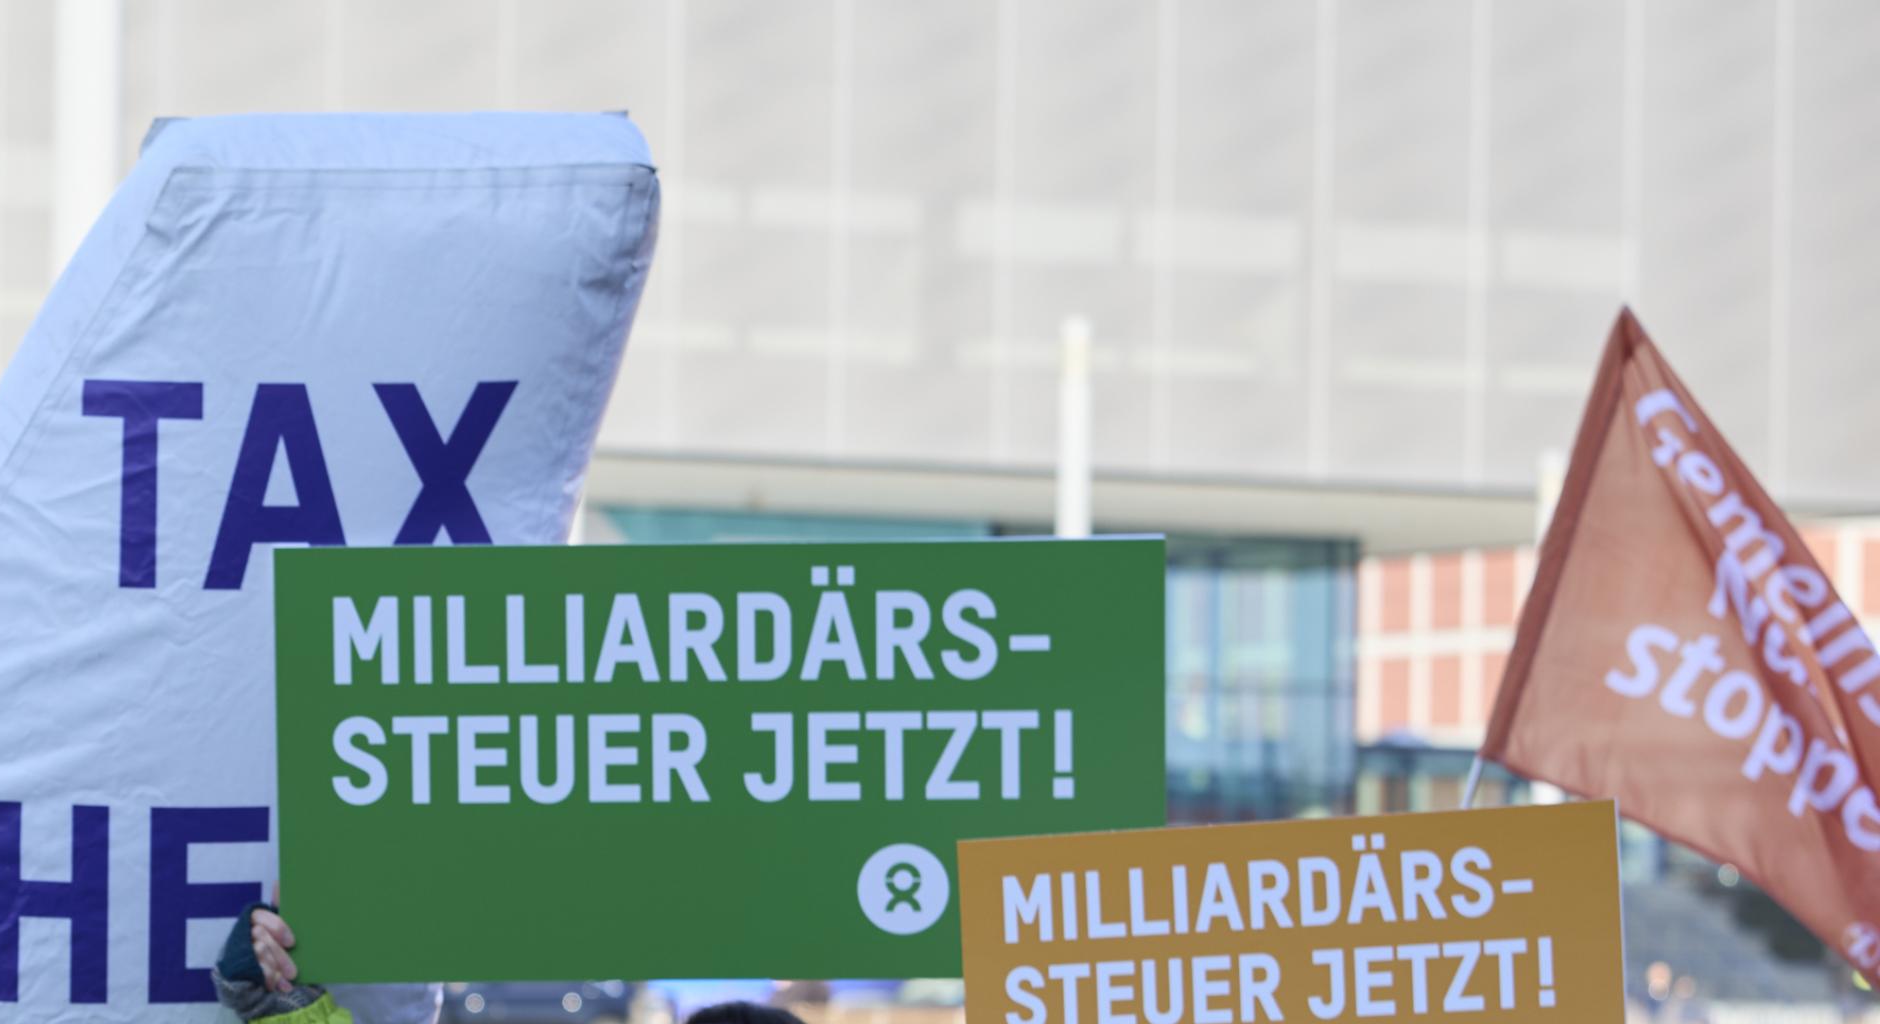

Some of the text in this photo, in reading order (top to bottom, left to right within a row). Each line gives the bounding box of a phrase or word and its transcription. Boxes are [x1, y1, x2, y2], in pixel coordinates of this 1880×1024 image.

[81, 378, 520, 590] TAX
[331, 565, 1052, 686] MILLIARDÄRS-
[331, 708, 1076, 806] STEUER JETZT!
[1000, 833, 1534, 944] MILLIARDÄRS-
[1307, 935, 1558, 1021] JETZT!
